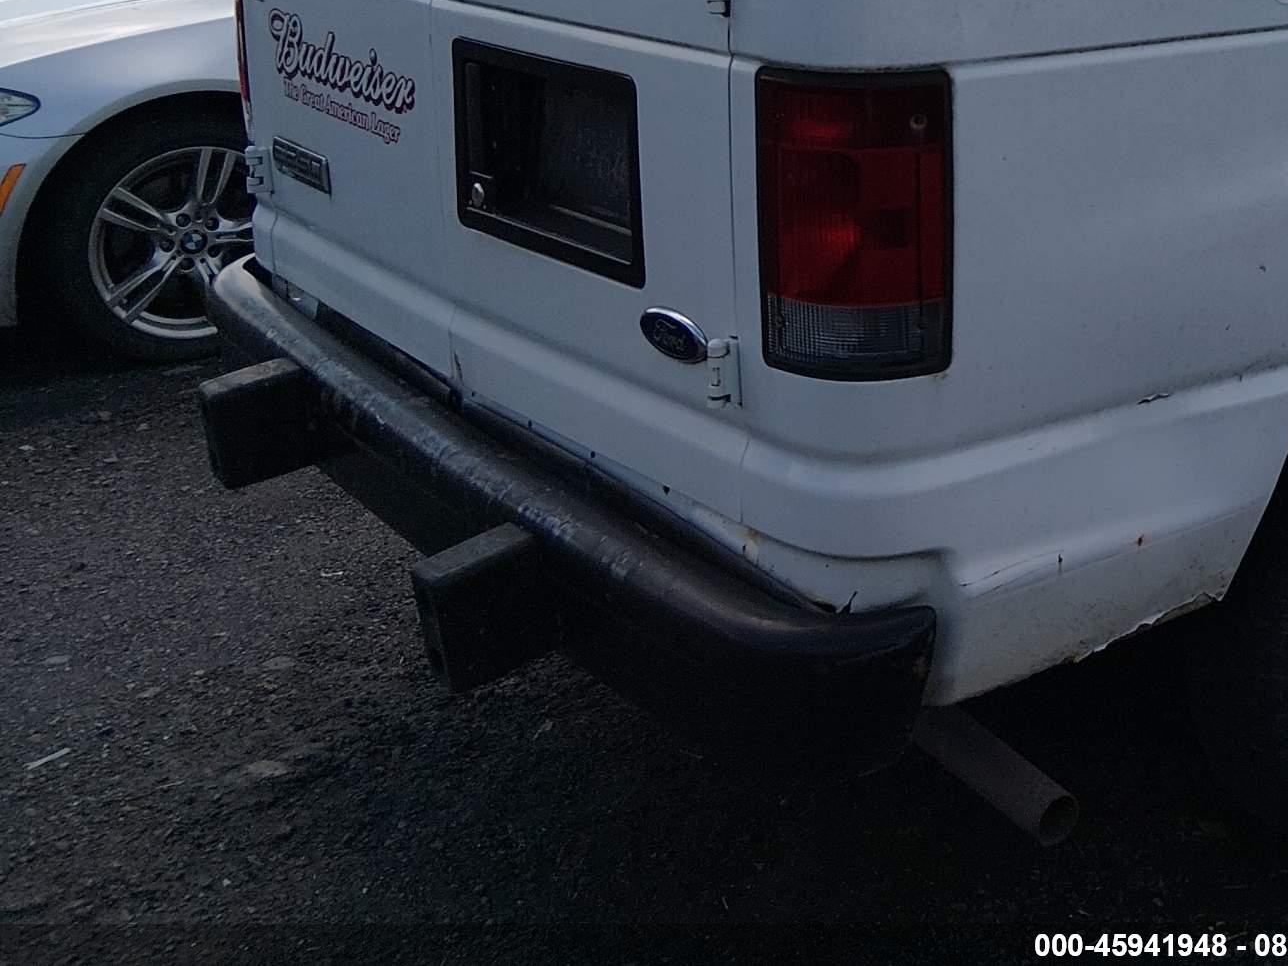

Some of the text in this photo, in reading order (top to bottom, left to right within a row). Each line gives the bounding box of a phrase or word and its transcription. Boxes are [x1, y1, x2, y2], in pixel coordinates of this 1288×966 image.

[269, 8, 416, 113] Budweiser
[283, 76, 401, 145] The Great American Lager
